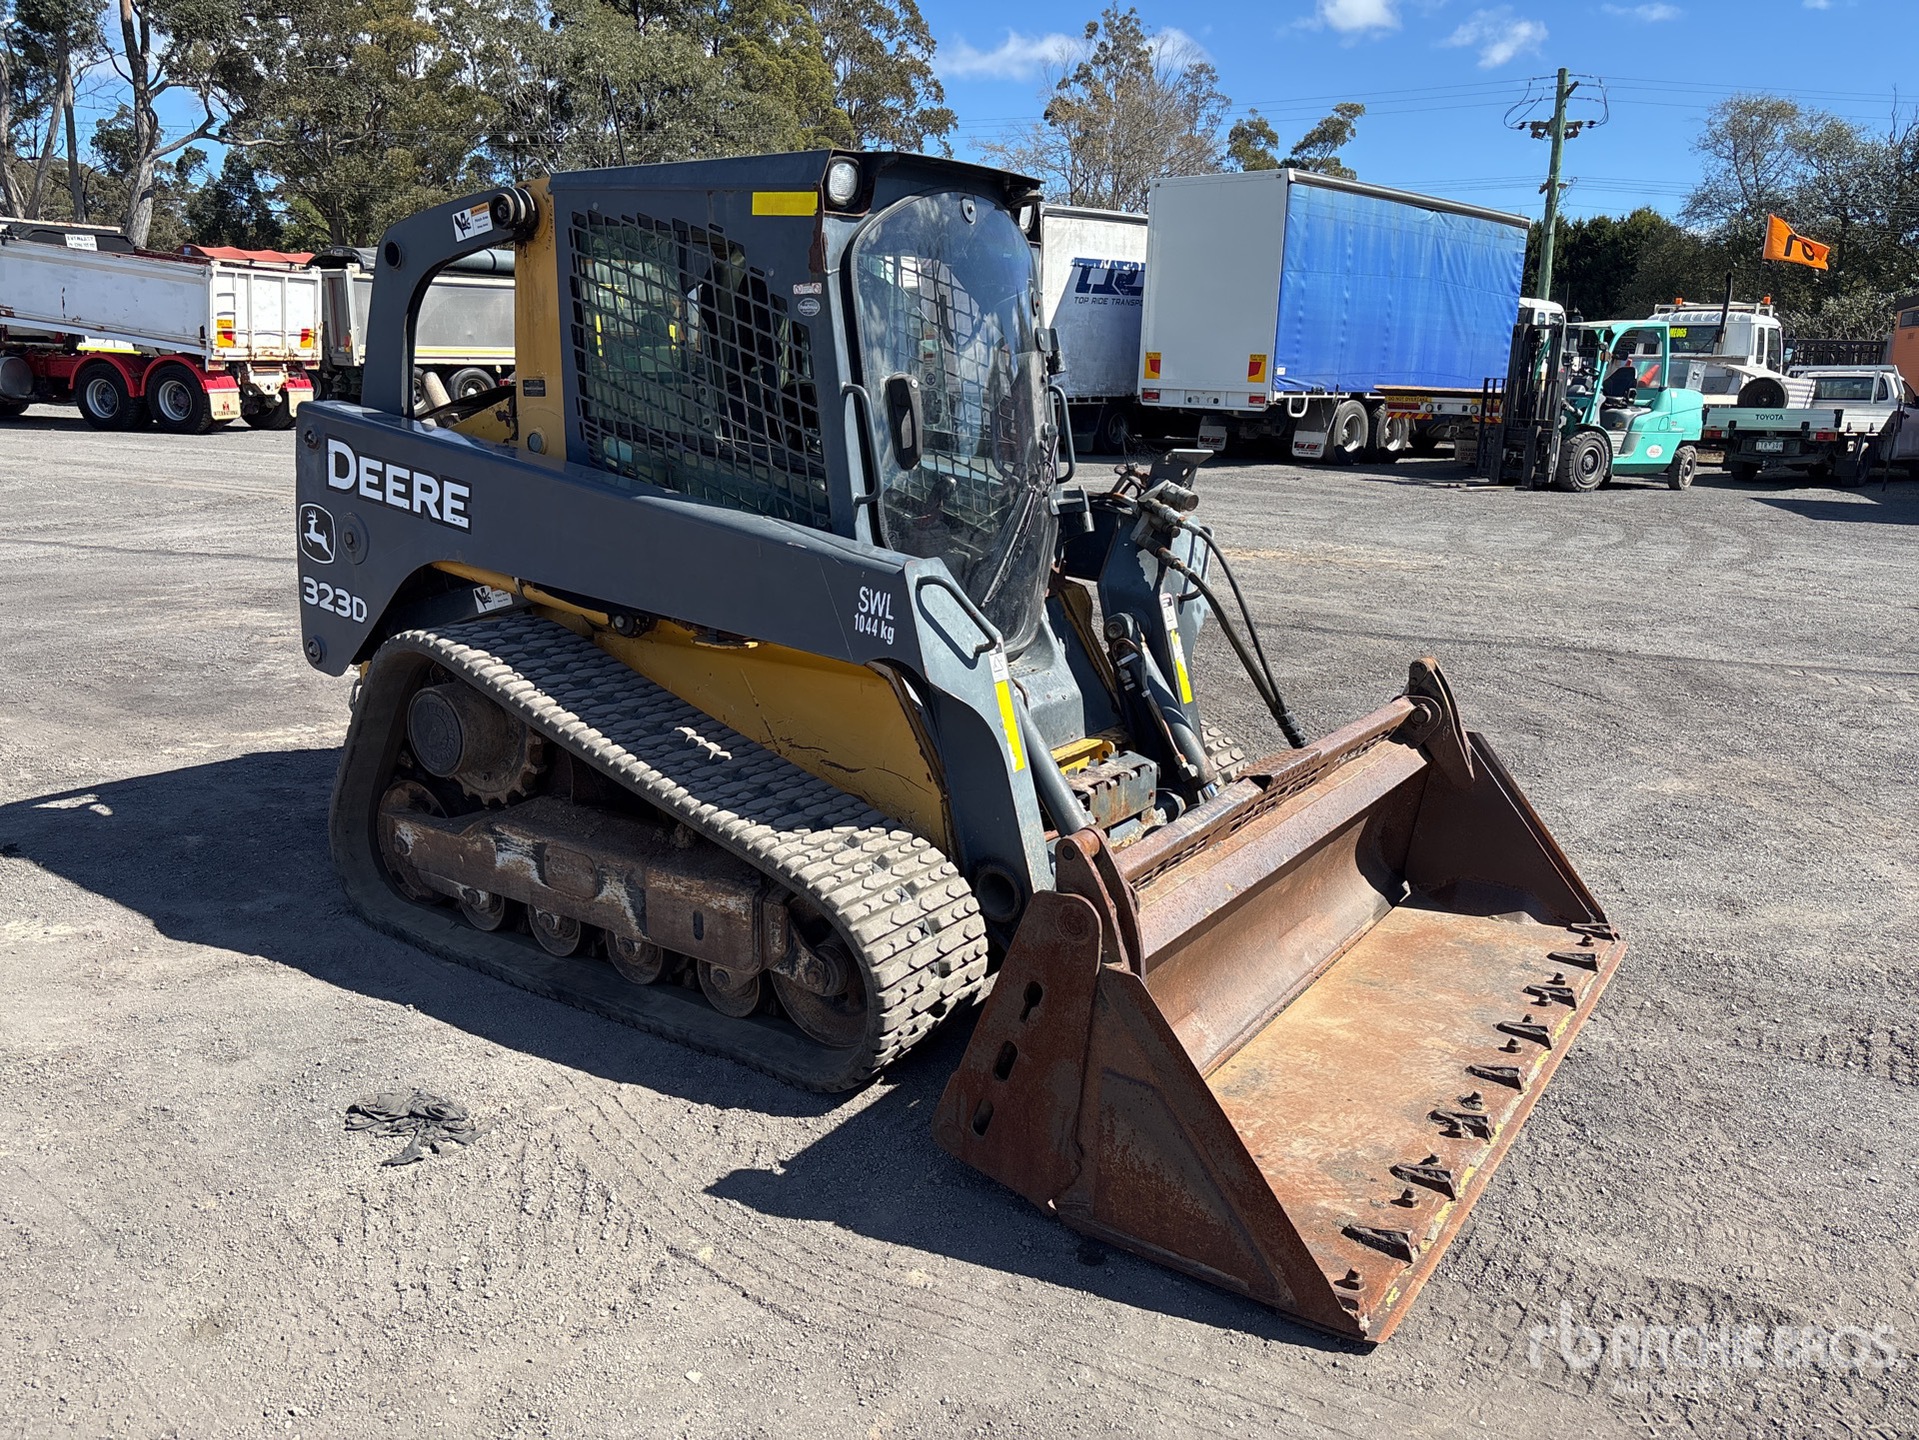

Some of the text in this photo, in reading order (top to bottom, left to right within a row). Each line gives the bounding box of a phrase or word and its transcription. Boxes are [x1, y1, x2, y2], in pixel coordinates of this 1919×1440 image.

[1091, 297, 1109, 305] RIDE
[327, 438, 470, 529] DEERE
[303, 576, 368, 623] 323D
[858, 586, 894, 620] SWL
[854, 612, 895, 645] 1044 kg
